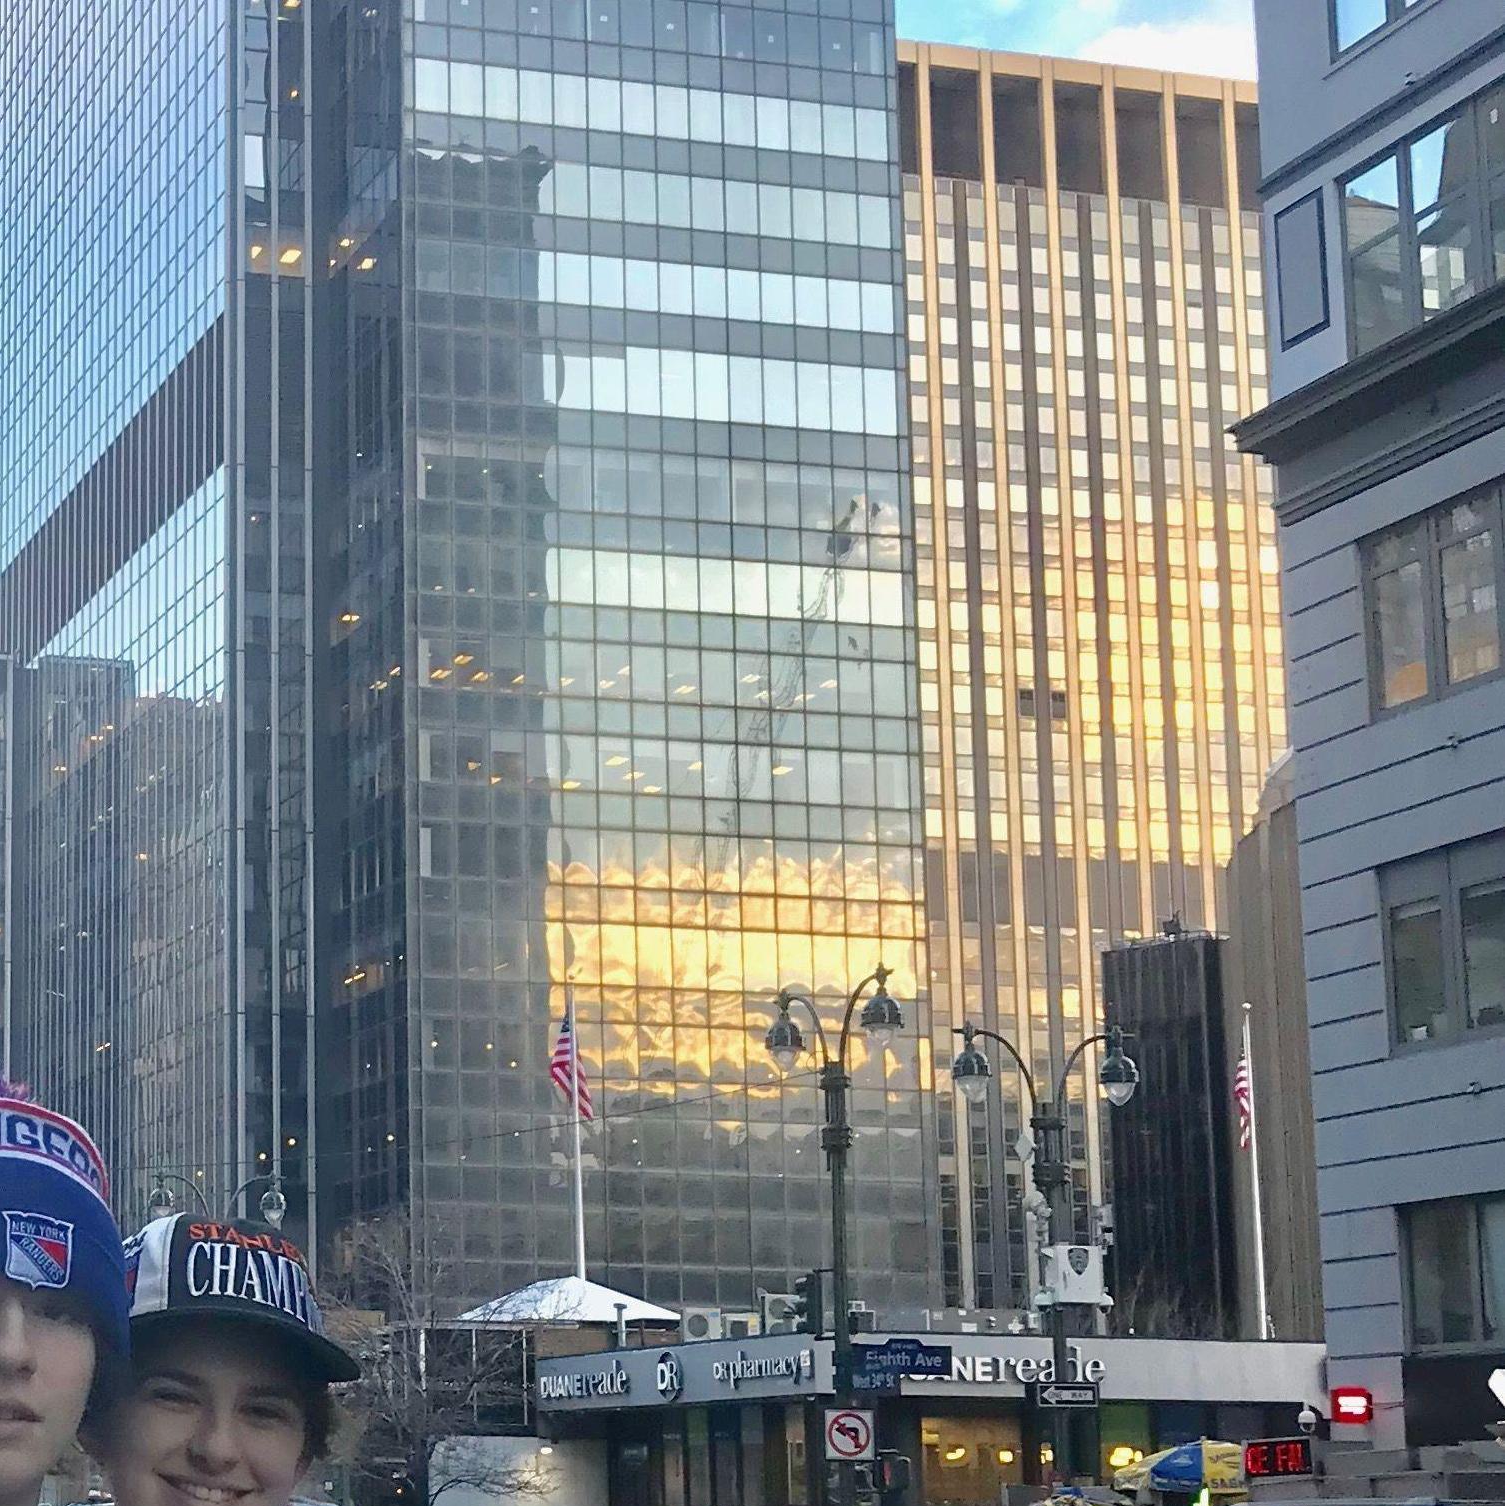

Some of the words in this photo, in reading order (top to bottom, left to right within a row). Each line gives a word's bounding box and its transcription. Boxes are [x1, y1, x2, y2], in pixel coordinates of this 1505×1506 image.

[11, 1221, 36, 1234] NEW
[39, 1225, 66, 1241] YORK
[19, 1237, 65, 1281] RANGERS
[729, 1350, 799, 1389] pharmacy
[915, 1352, 942, 1367] Ave
[657, 1361, 681, 1391] DR
